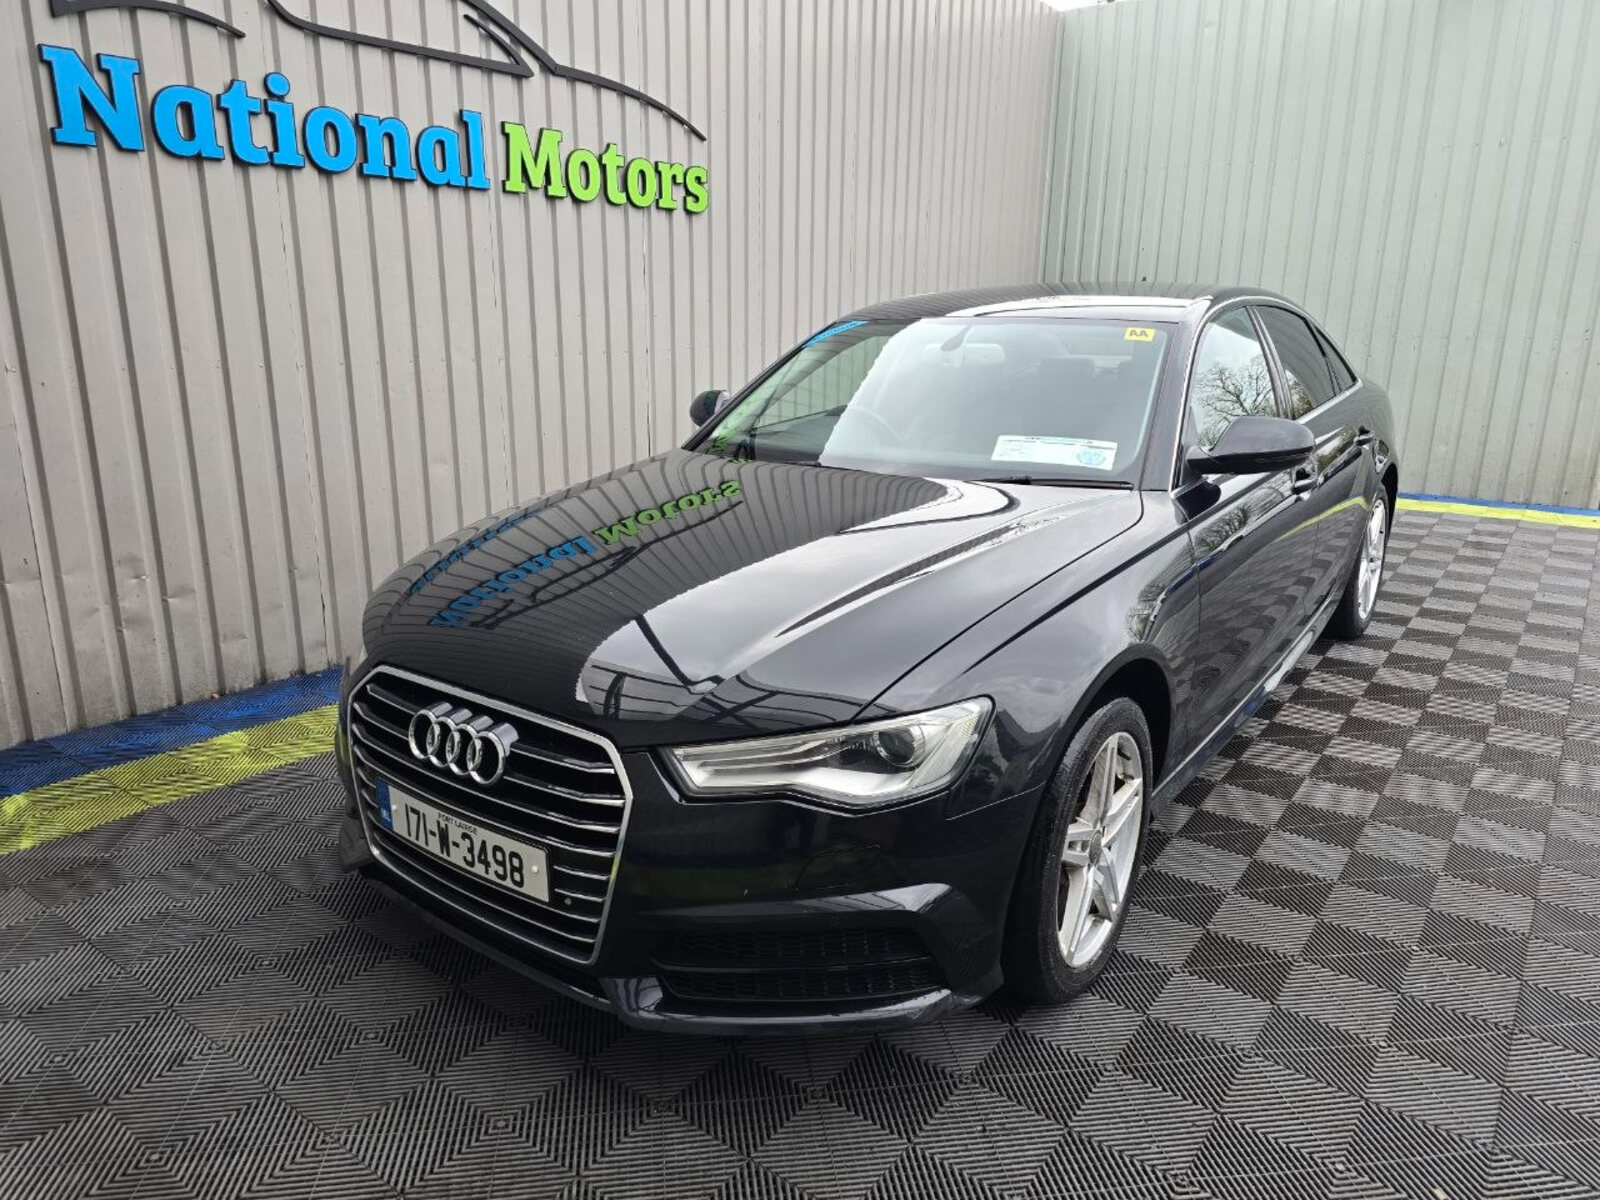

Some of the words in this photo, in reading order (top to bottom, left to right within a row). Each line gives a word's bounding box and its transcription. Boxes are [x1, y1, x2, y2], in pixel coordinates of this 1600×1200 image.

[38, 44, 490, 190] National
[502, 120, 708, 214] Motors
[1128, 329, 1149, 338] AA
[405, 803, 525, 888] 171-W-3498
